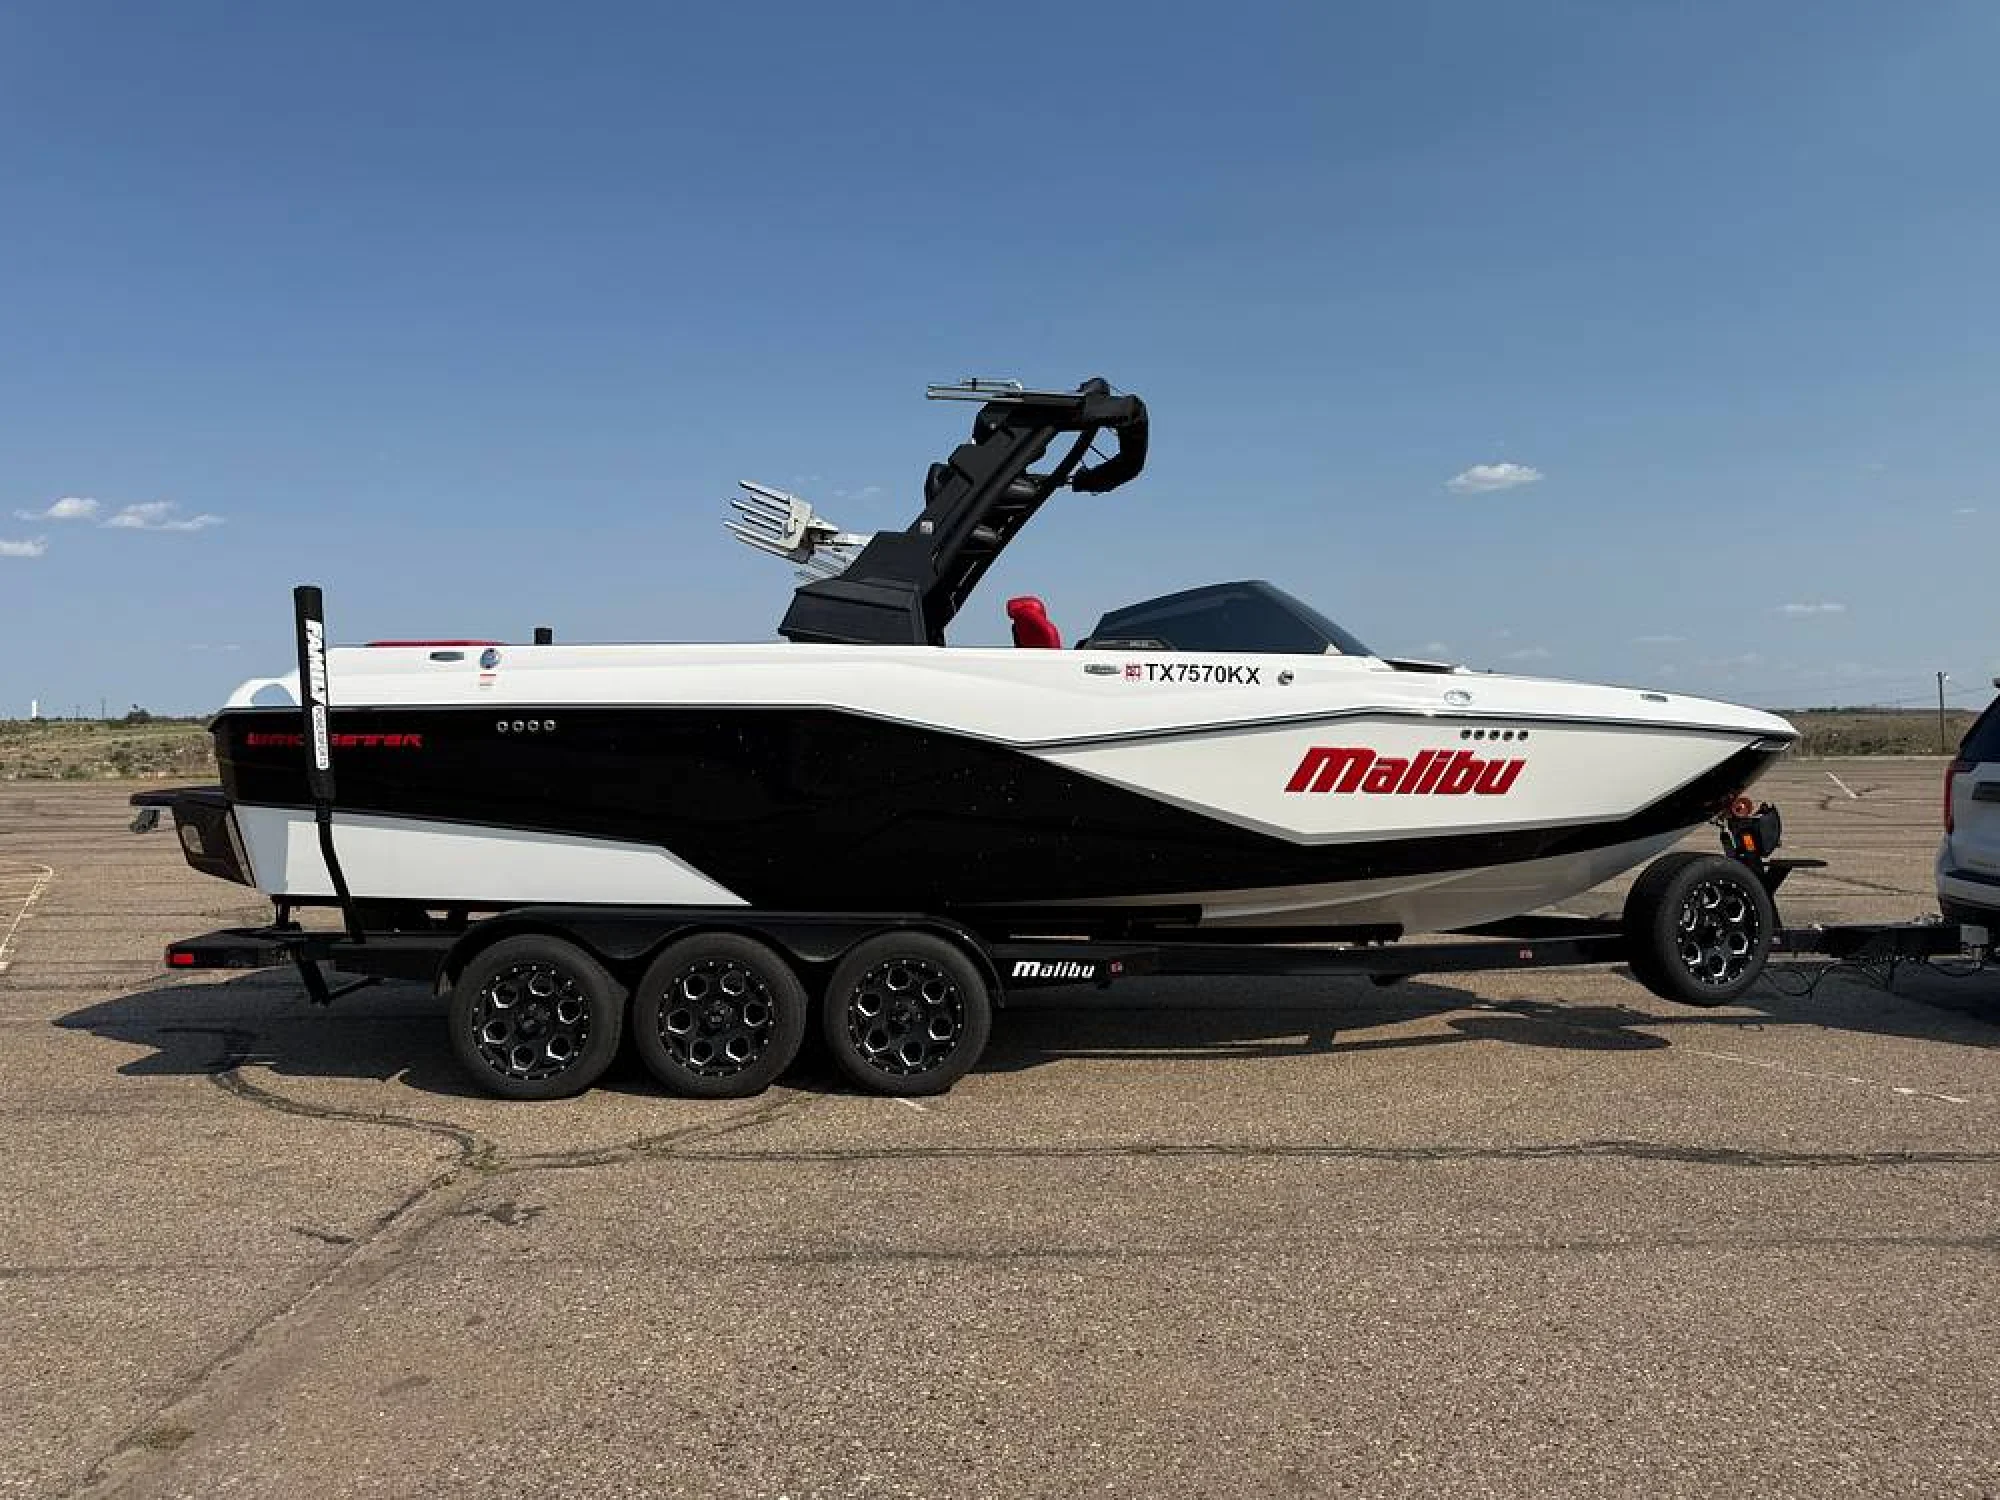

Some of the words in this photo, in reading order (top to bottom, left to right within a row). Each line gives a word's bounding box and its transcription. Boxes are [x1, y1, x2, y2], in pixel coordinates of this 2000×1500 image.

[1145, 663, 1260, 684] TX7570KX
[1284, 746, 1526, 795] Malibu
[1012, 961, 1095, 978] Malibu
